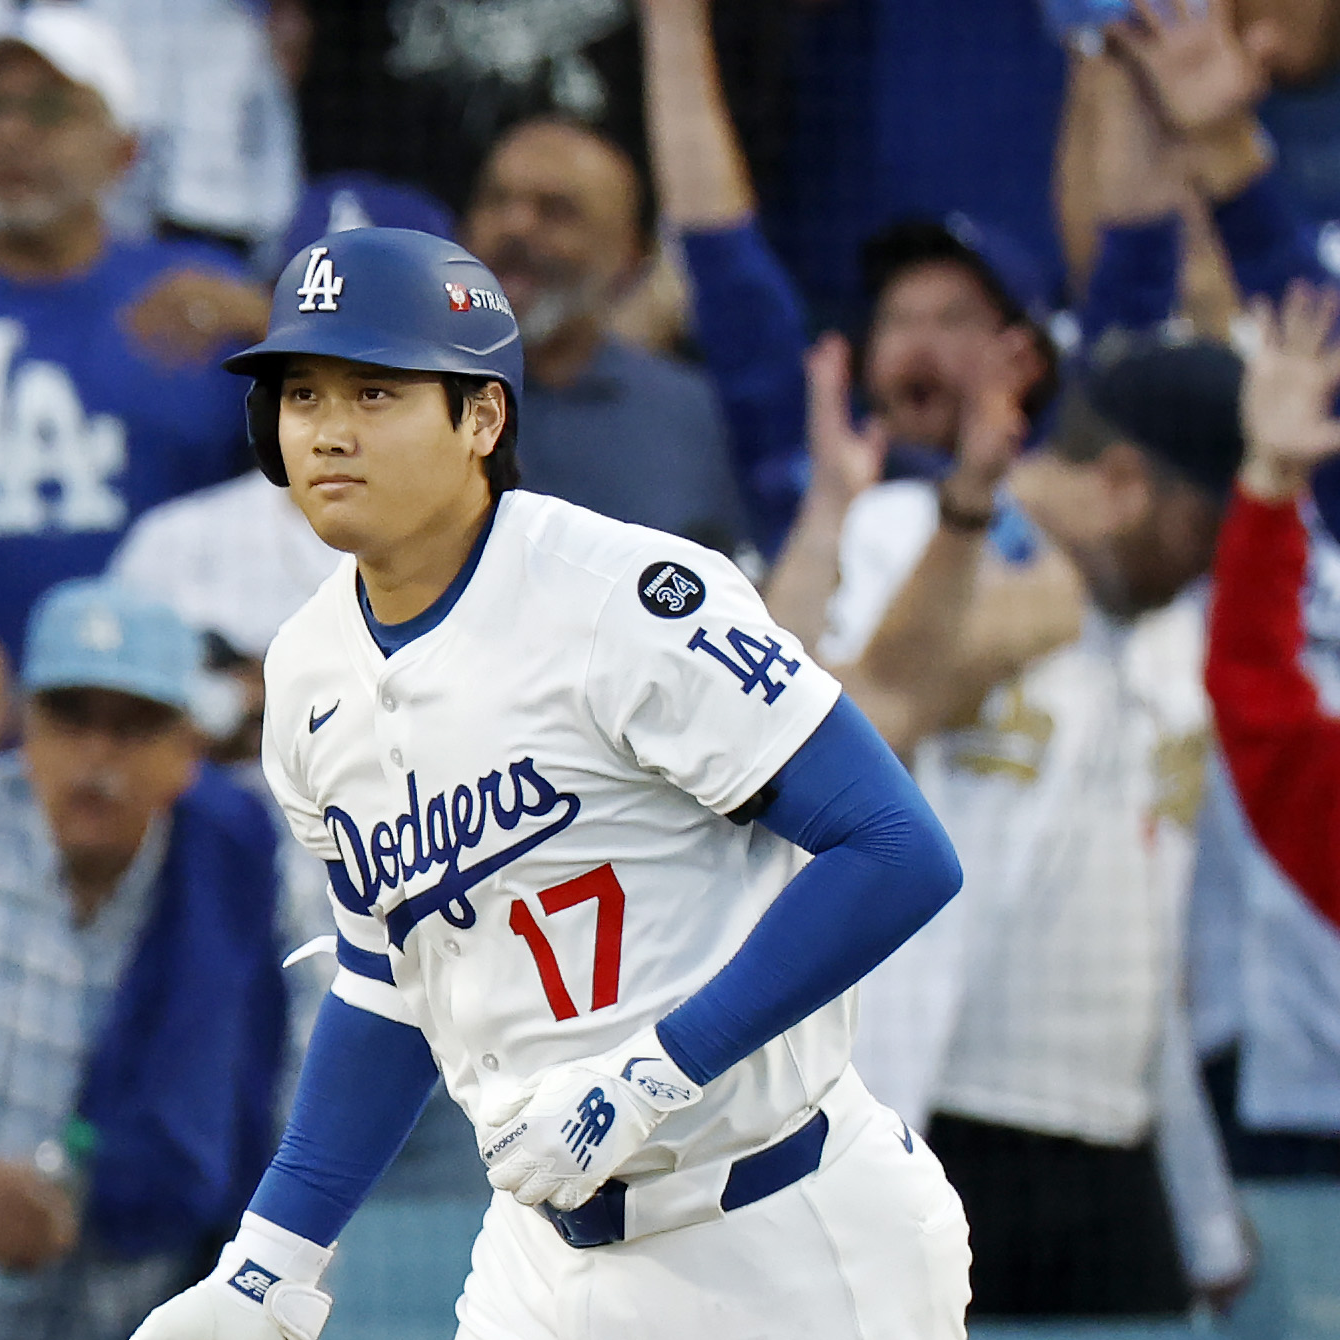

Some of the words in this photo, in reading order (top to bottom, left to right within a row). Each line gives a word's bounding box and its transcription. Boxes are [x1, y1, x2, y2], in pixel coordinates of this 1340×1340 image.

[296, 247, 344, 312] LA
[469, 287, 516, 322] STRAU
[656, 572, 700, 612] 34
[686, 626, 802, 706] LA
[324, 756, 581, 940] Dodgers
[509, 862, 626, 1022] 17
